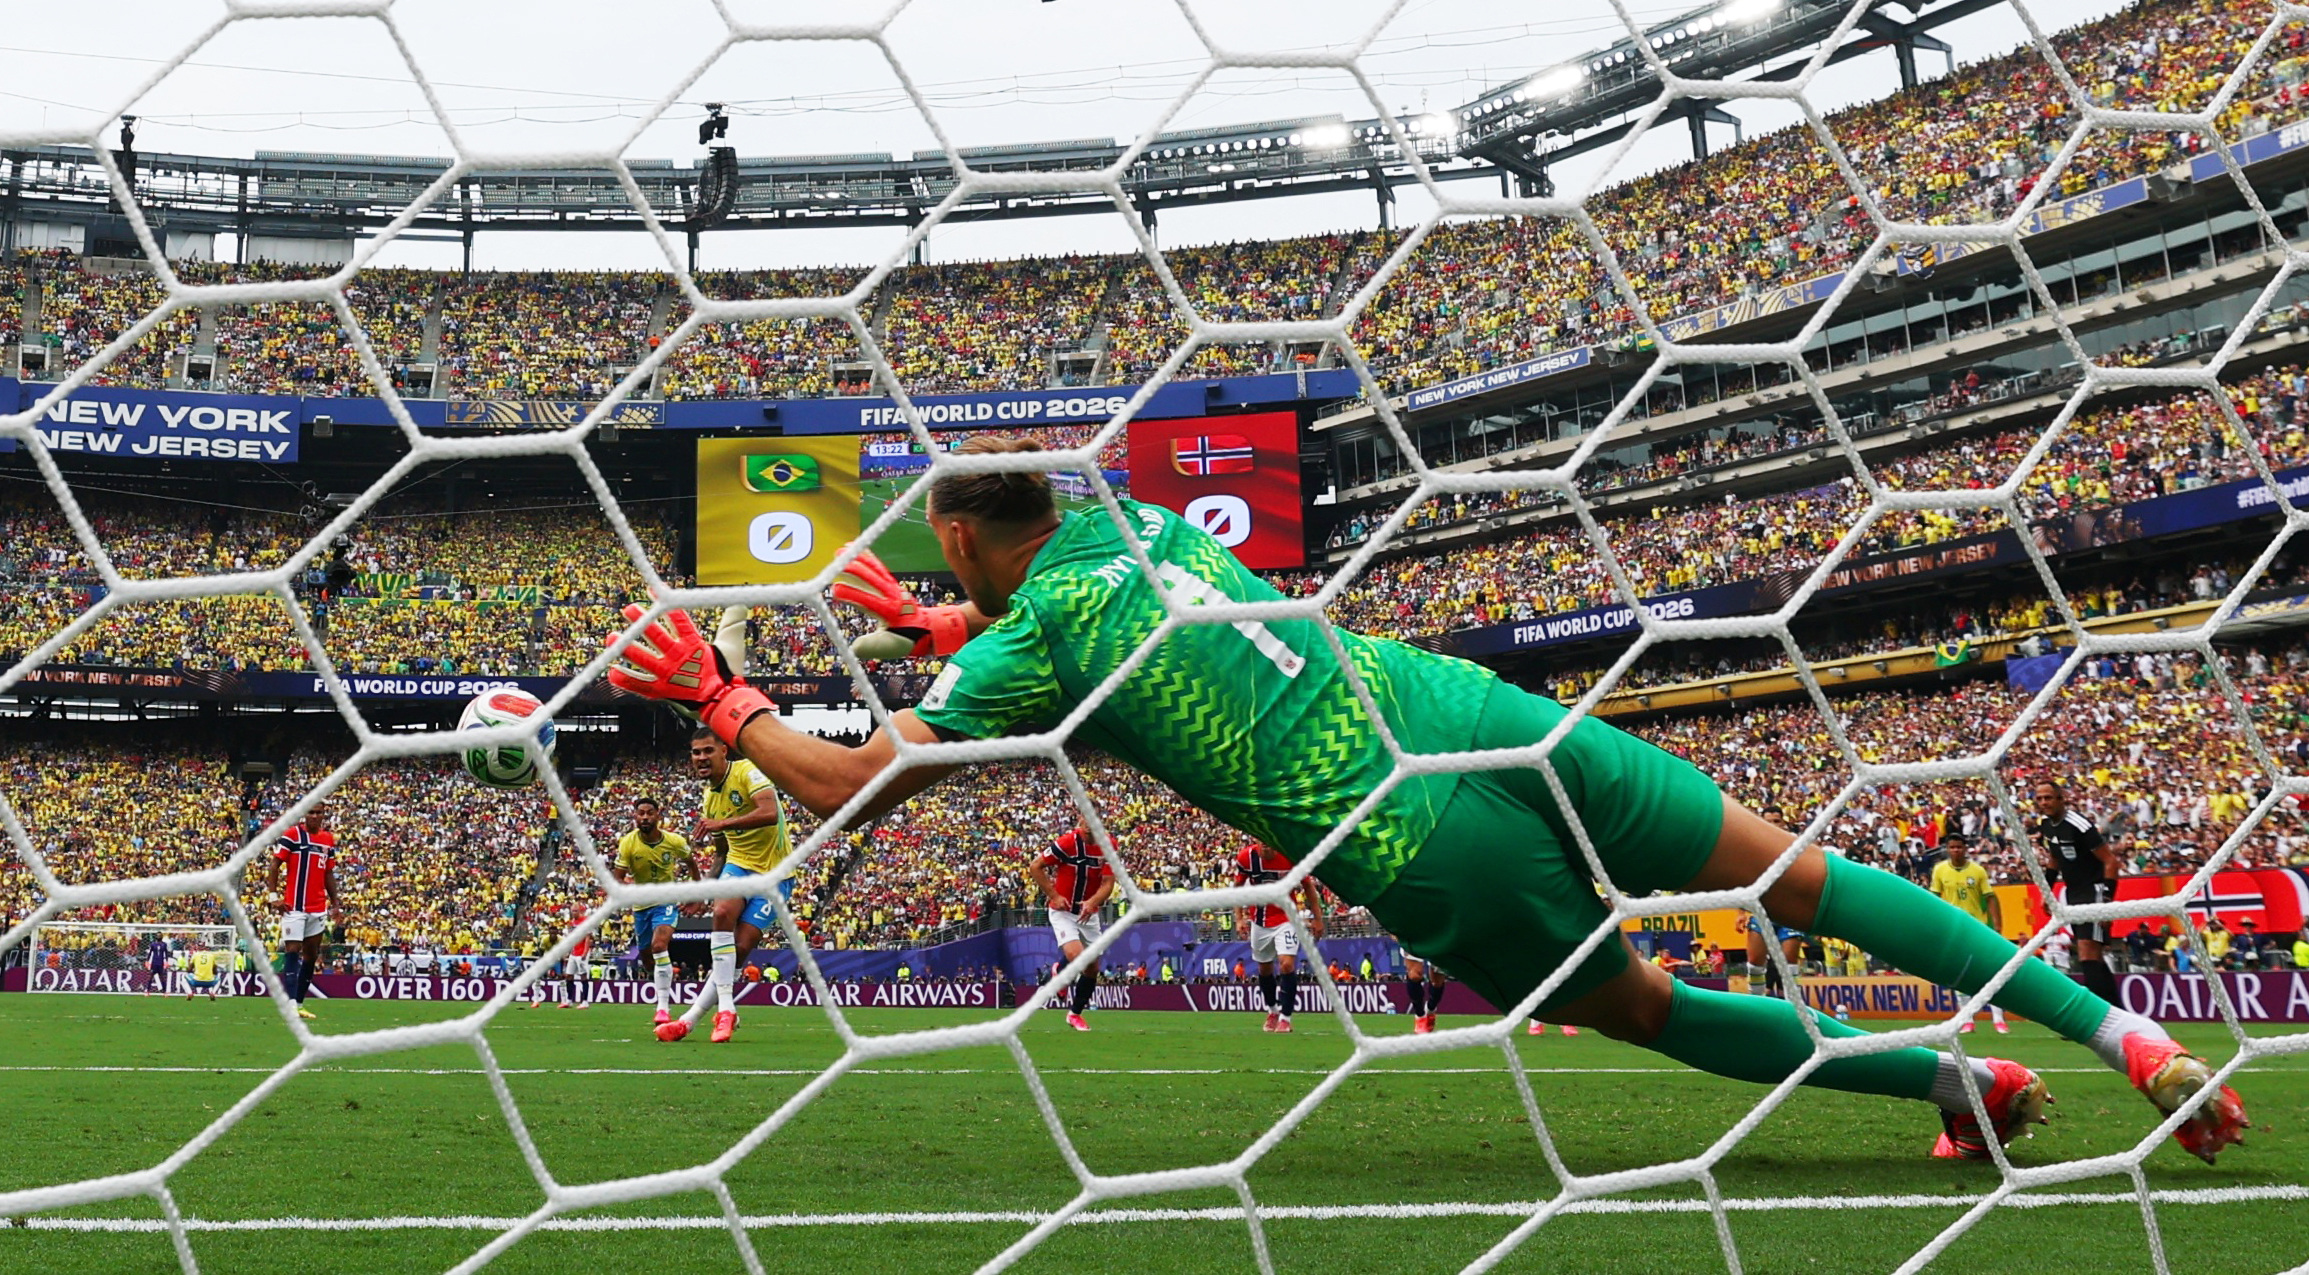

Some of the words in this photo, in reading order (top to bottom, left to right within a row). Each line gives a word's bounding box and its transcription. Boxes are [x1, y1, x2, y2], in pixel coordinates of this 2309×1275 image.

[1415, 388, 1445, 405] NEW
[1448, 378, 1486, 397] YORK
[1487, 367, 1519, 386] NEW
[1522, 352, 1579, 377] JERSEY
[35, 399, 146, 427] NEW
[157, 404, 292, 434] YORK
[861, 407, 909, 426] FIFA
[912, 403, 993, 424] WORLD
[997, 400, 1042, 420] CUP
[1046, 396, 1127, 417] 2026
[36, 429, 123, 453] NEW
[131, 435, 290, 460] JERSEY
[876, 445, 903, 454] 13:22
[1184, 494, 1251, 548] 0
[749, 511, 813, 565] 0
[1852, 563, 1895, 584] YORK
[1899, 554, 1934, 575] NEW
[1937, 541, 1997, 568] JERSEY
[1514, 624, 1546, 645] FIFA
[1547, 614, 1601, 639] WORLD
[1603, 608, 1635, 629] CUP
[45, 671, 85, 684] YORK
[88, 672, 122, 685] NEW
[125, 673, 184, 687] JERSEY
[314, 678, 351, 692] FIA
[354, 679, 417, 694] WORLD
[421, 680, 456, 695] CUP
[763, 682, 820, 695] JERSEY
[1957, 887, 1967, 900] 16
[665, 905, 674, 916] 9
[1641, 914, 1706, 939] BRAZIL
[1203, 958, 1228, 975] FIFA
[35, 968, 132, 992] QATAR
[355, 976, 432, 1000] OVER
[441, 978, 485, 1001] 160
[771, 983, 861, 1007] QAAR
[872, 983, 985, 1006] AIRWAYS
[1088, 985, 1131, 1009] RWAYS
[1208, 985, 1245, 1010] OVER
[1275, 984, 1389, 1013] STINTIONS
[1815, 984, 1868, 1011] YORK
[1873, 984, 1918, 1012] NEW
[2121, 972, 2269, 1019] QATAR
